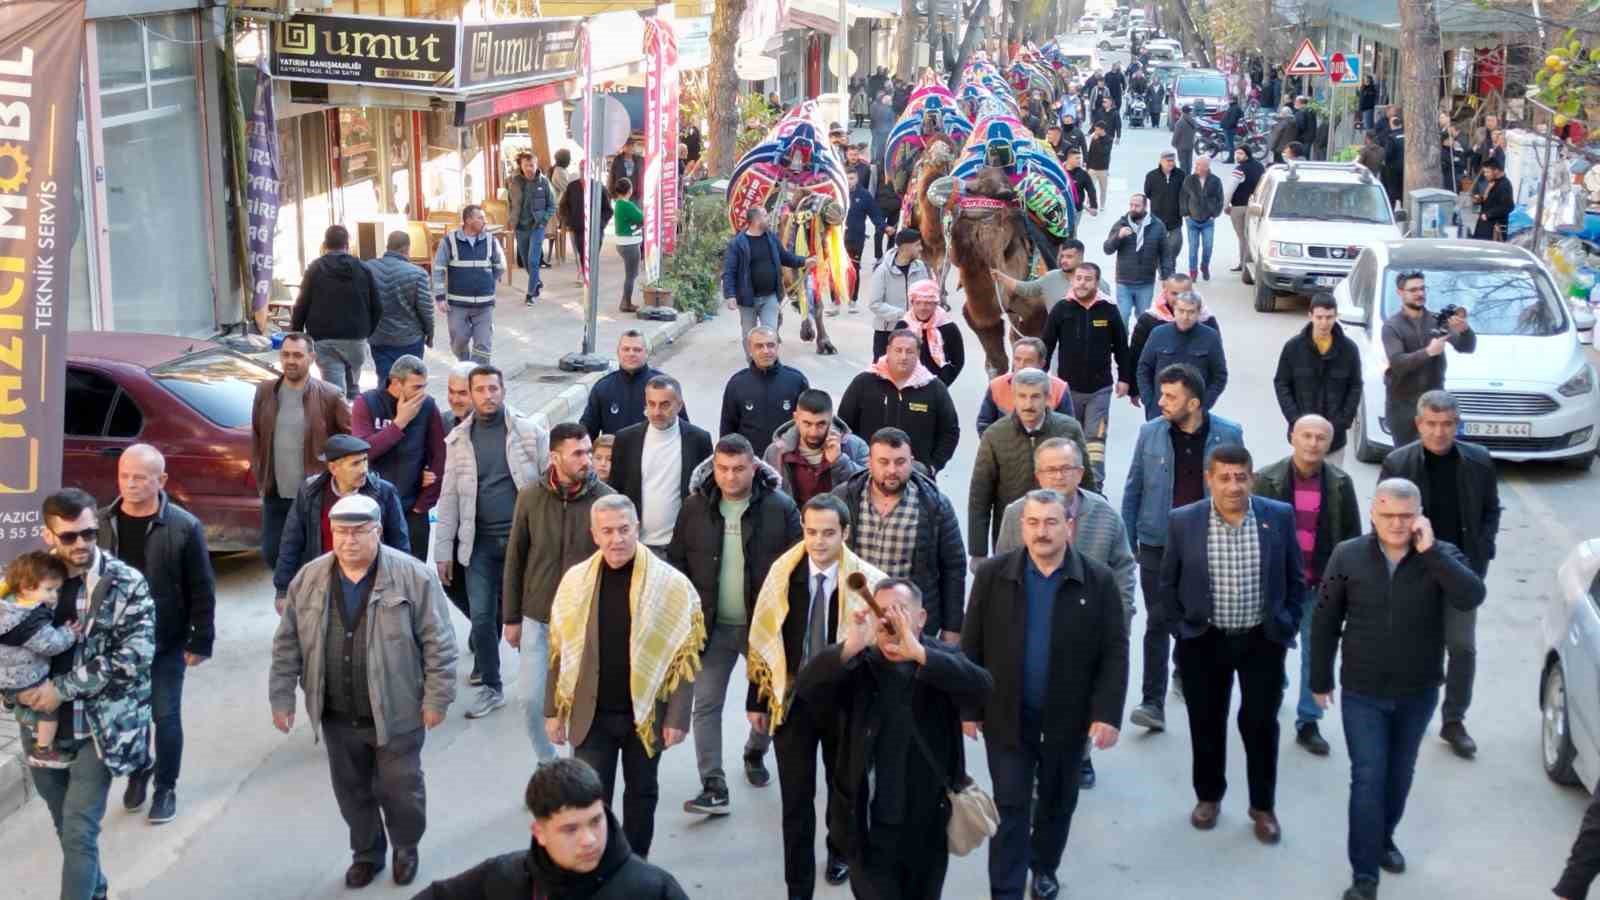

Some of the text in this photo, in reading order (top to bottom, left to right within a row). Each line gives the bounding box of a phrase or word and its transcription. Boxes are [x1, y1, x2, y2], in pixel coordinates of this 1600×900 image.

[322, 30, 440, 62] umut
[493, 29, 543, 75] umut
[33, 181, 57, 330] TEKNİK SERVİS
